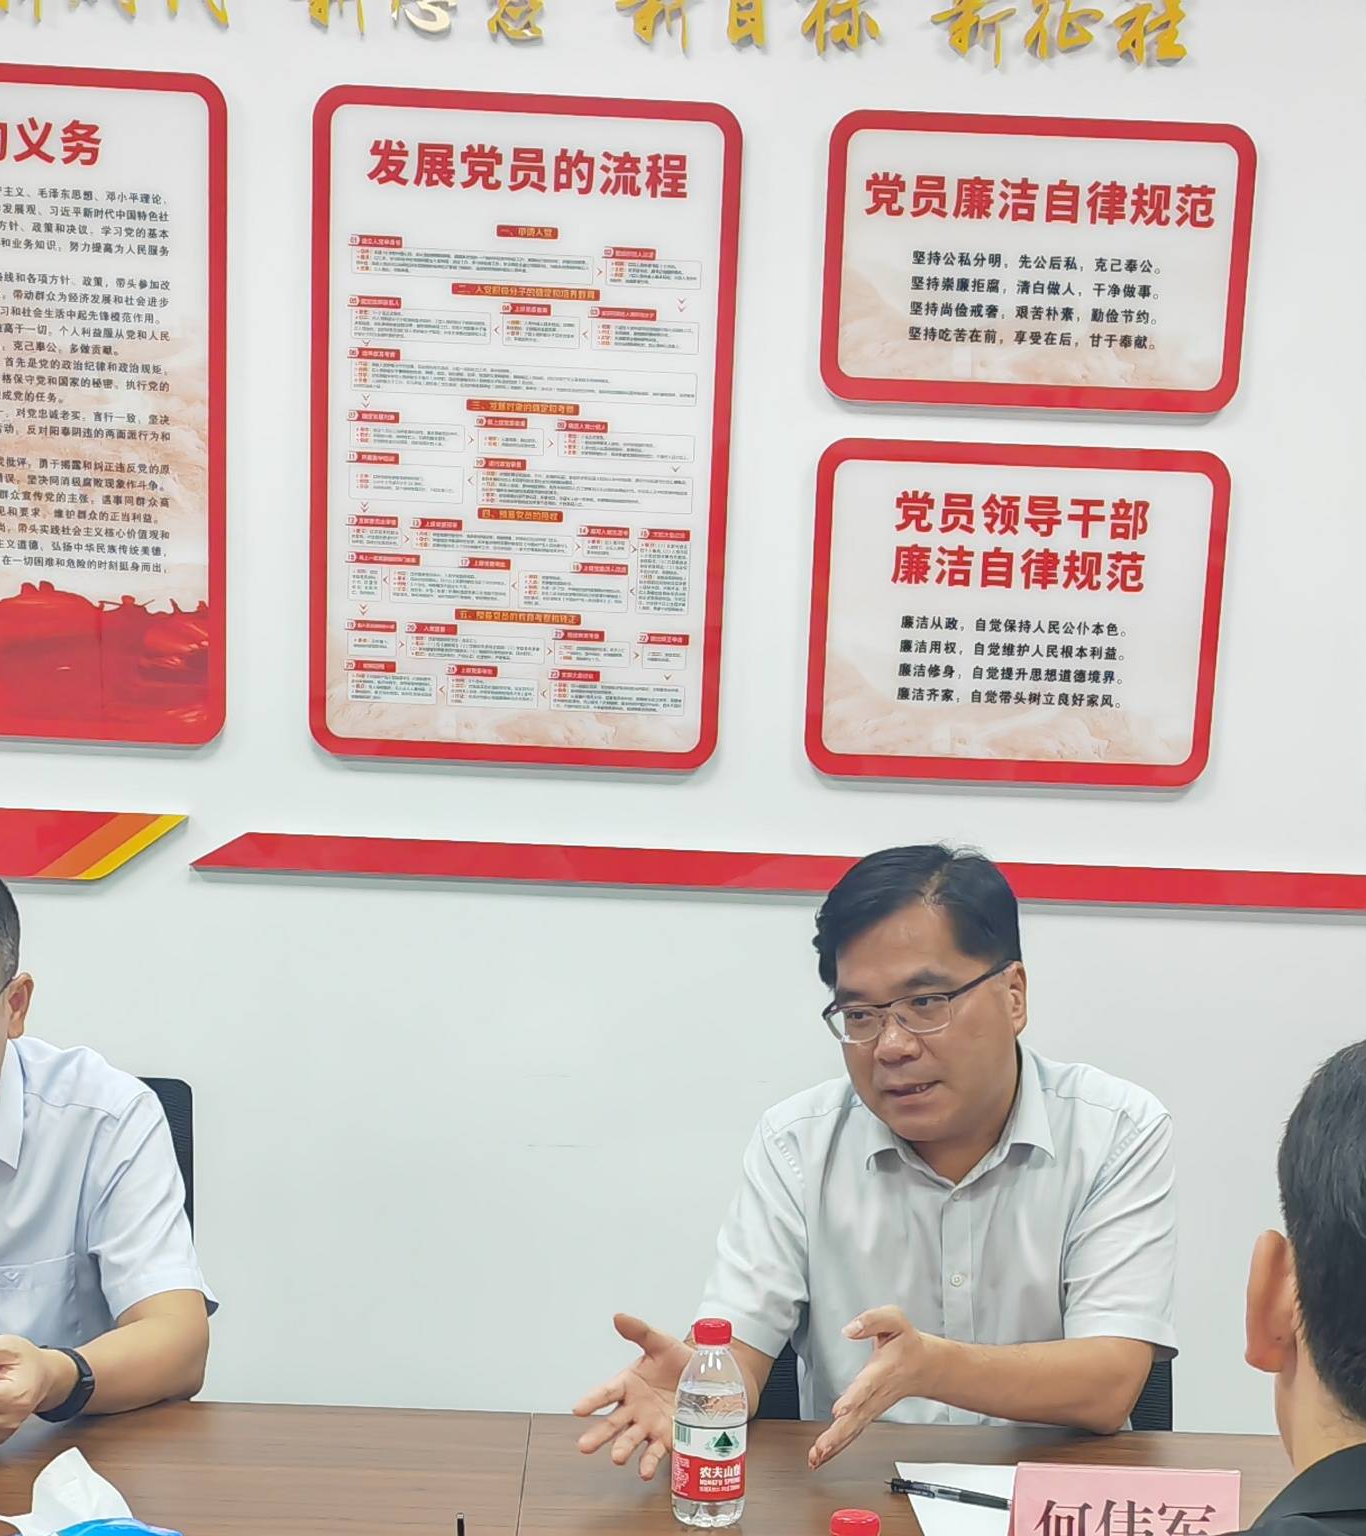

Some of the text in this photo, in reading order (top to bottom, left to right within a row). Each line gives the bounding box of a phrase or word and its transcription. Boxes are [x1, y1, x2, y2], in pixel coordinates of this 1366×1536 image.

[368, 139, 688, 199] 发展党员的流程
[864, 172, 1217, 229] 党员廉洁自律规范
[912, 250, 1161, 275] 坚持公私分明，先公后私，克己奉公。
[910, 276, 1159, 300] 坚持崇廉拒腐，清白做人，干净做事。
[909, 301, 1157, 325] 坚持尚俭戒奢，艰苦朴素，勤俭节约。
[908, 326, 1155, 350] 坚持吃苦在前，享受在后，甘于奉献。
[894, 490, 1150, 541] 党员领导干部
[891, 544, 1145, 595] 廉洁自律规范
[901, 615, 1126, 637] 廉洁从政，自觉保持人民公仆本色。
[899, 639, 1125, 661] 廉洁用权，自觉维护人民根本利益。
[898, 663, 1123, 685] 廉洁修身，自觉提升思想道德境界。
[896, 687, 1121, 709] 廉洁齐家，自觉带头树立良好家风。
